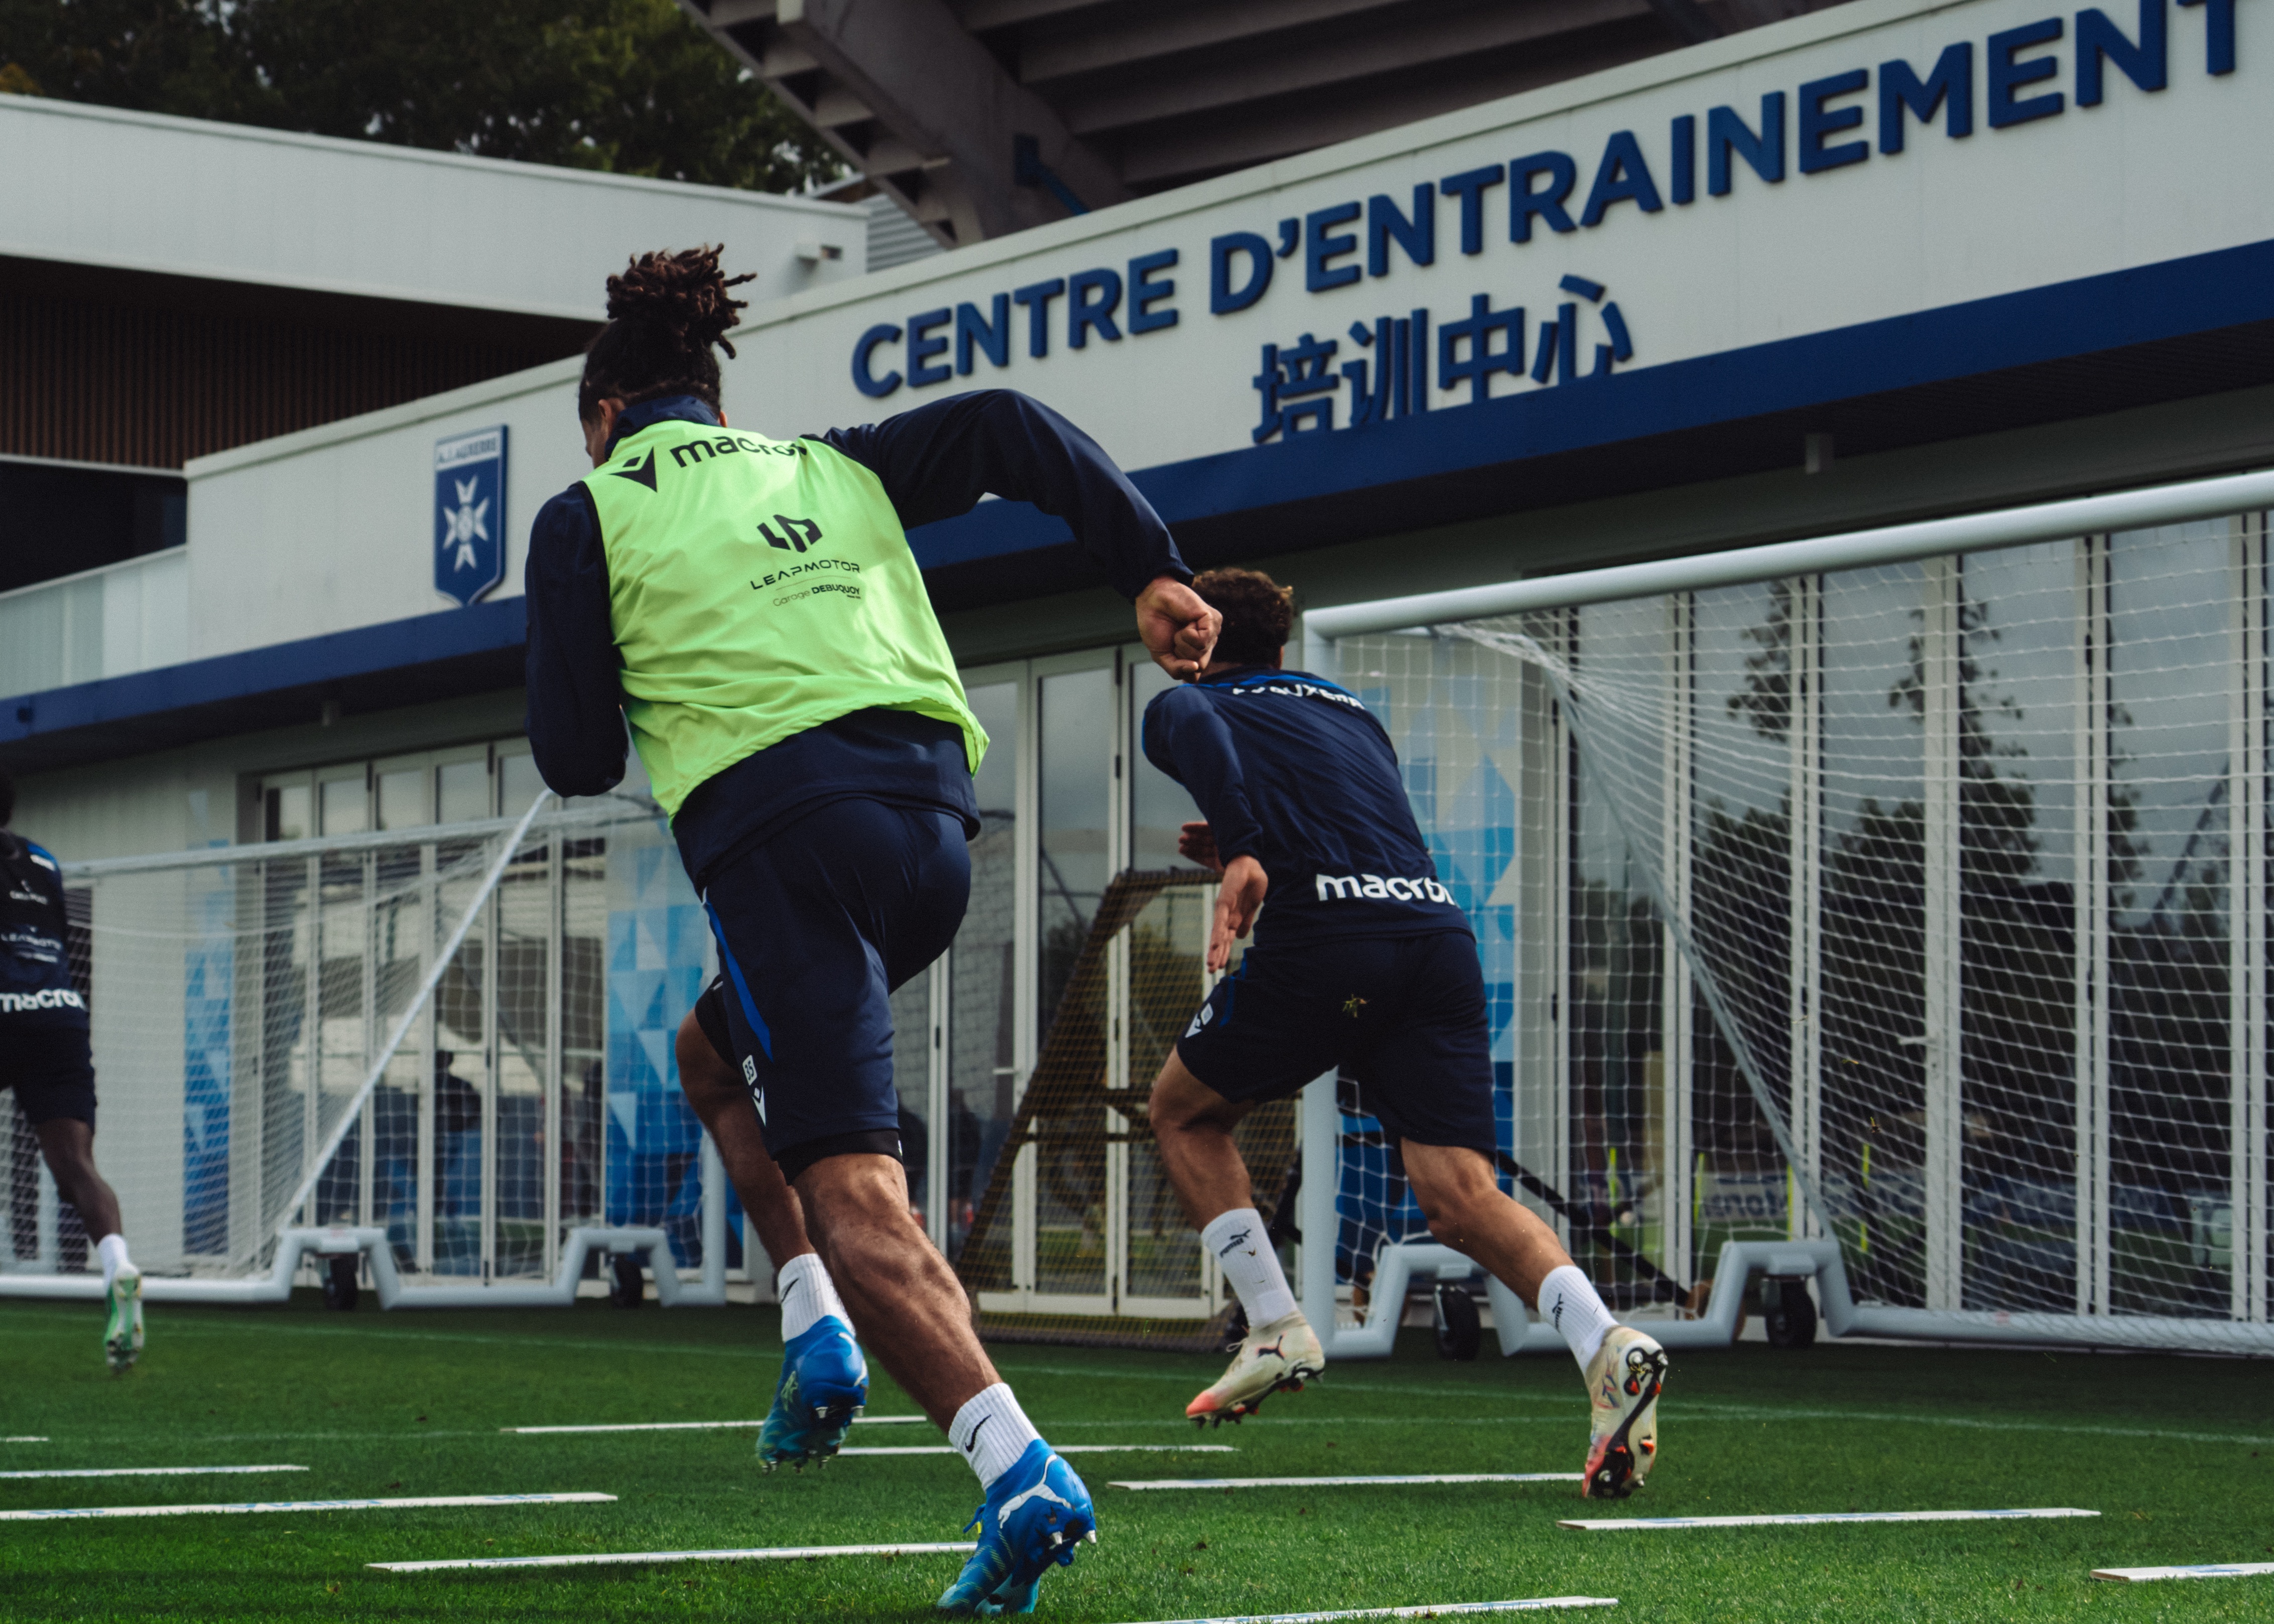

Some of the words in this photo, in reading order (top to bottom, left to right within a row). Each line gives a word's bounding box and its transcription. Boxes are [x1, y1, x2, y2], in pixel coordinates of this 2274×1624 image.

[851, 248, 1179, 398] CENTRE
[1210, 0, 2236, 316] D'ENTRAINEMENT
[1252, 274, 1633, 446] 培训中心
[750, 560, 860, 590] LEAPMOTOR
[773, 590, 811, 606] Garage
[811, 584, 860, 595] DEBUQUOY
[744, 1060, 754, 1080] 35
